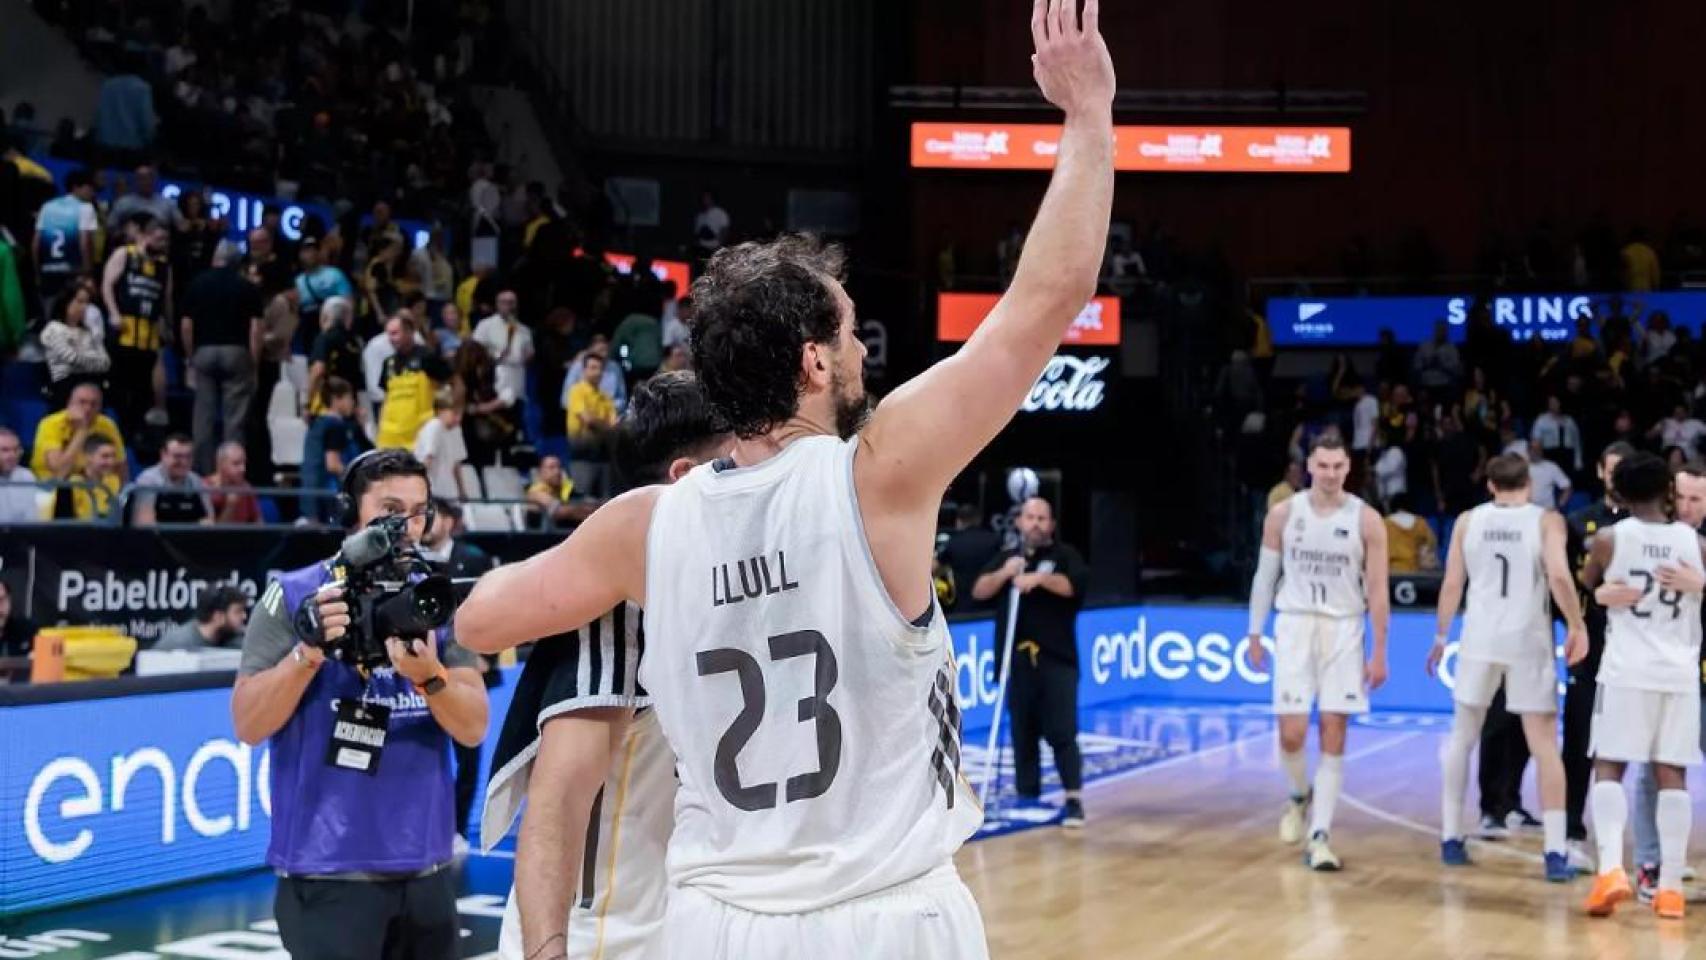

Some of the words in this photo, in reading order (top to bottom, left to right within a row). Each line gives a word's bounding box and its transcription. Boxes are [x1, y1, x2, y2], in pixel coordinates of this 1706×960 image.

[51, 229, 66, 258] 2
[1447, 296, 1593, 325] SRING
[712, 551, 799, 607] LLULL
[1310, 582, 1327, 606] 11
[1394, 580, 1417, 605] G
[1494, 553, 1509, 598] 1
[1629, 570, 1684, 619] 24
[696, 629, 842, 812] 23
